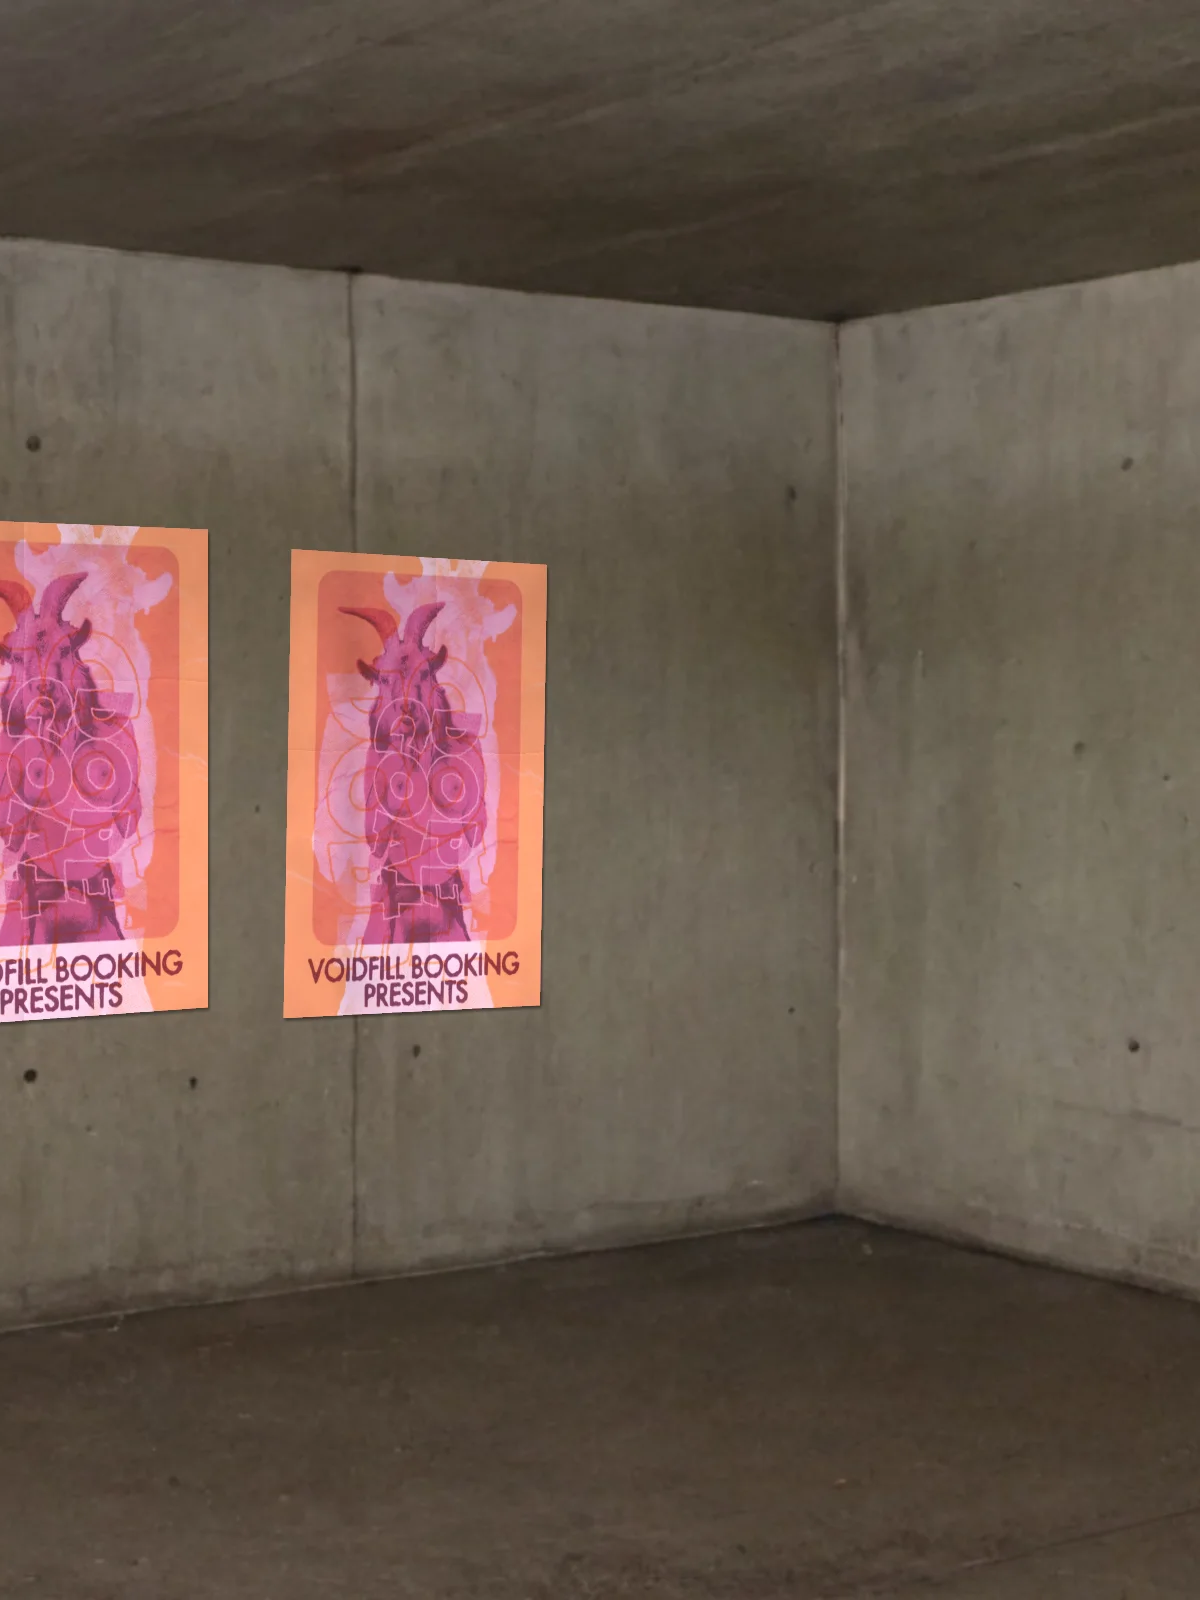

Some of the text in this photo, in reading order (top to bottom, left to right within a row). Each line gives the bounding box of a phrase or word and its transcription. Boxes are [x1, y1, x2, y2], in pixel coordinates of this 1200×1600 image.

[64, 687, 136, 905] DOPE
[55, 949, 184, 983] BOOKING
[307, 951, 520, 984] VOIDFILL BOOKING
[0, 981, 124, 1015] PRESENTS
[364, 980, 468, 1007] PRESENTS
